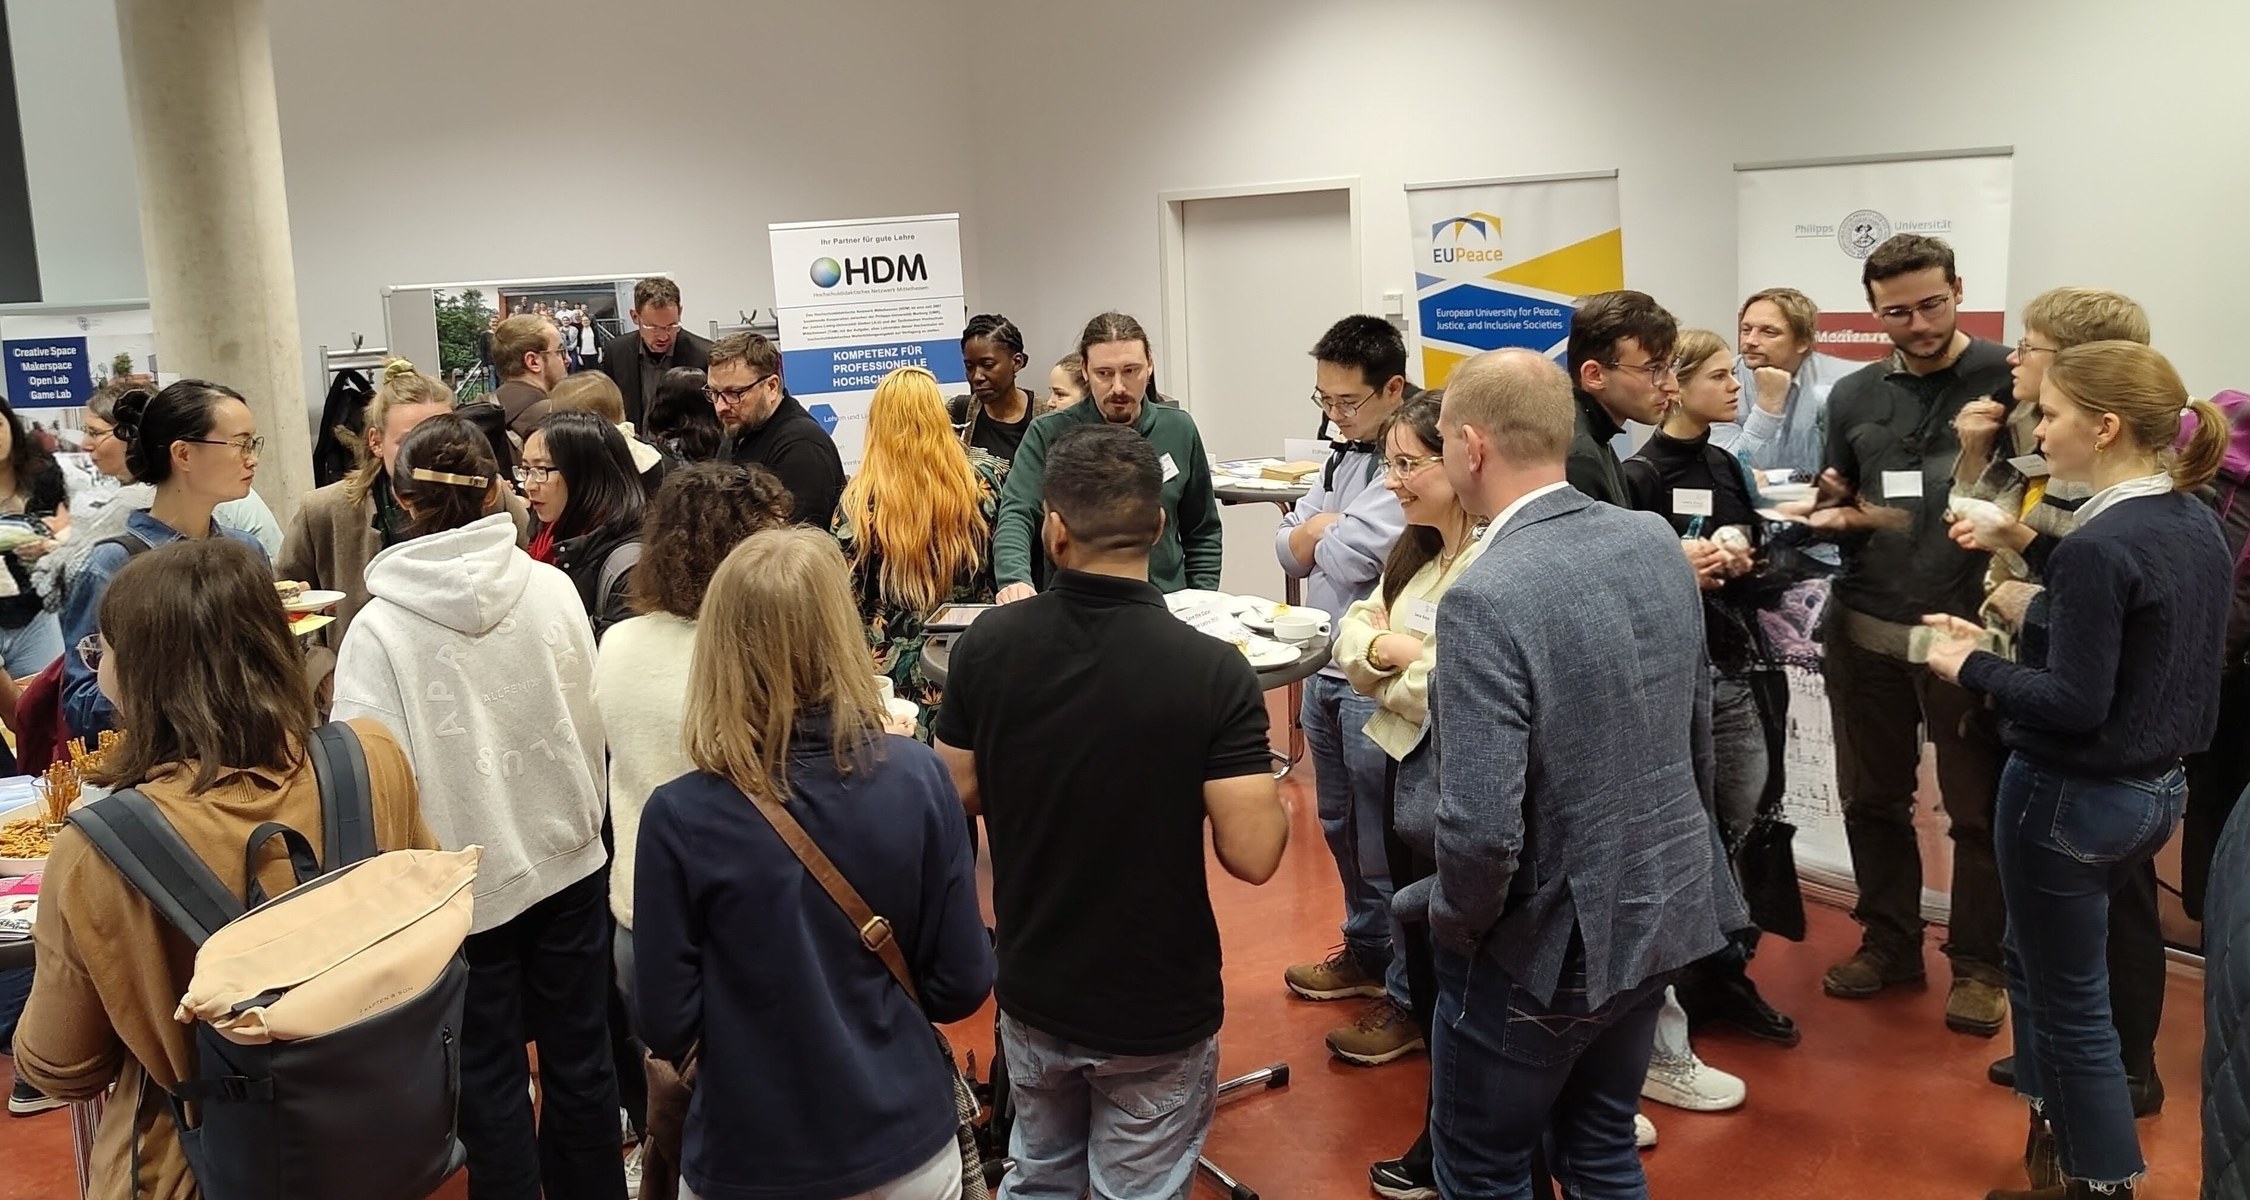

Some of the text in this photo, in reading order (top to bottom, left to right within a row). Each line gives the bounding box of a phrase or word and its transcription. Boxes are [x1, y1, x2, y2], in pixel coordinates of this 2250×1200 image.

[1795, 219, 1951, 235] Philipps Universität
[833, 237, 860, 245] Partner
[875, 235, 892, 243] gute
[894, 233, 915, 241] Lehre
[1433, 247, 1503, 263] EUPeace
[844, 253, 928, 286] HDM
[1436, 306, 1562, 319] European University for Peace,
[1436, 320, 1563, 331] Justice, and Inclusive Societies
[13, 346, 77, 358] Creative Space
[833, 345, 922, 361] KOMPETENZ FÜR
[21, 361, 73, 372] Makerspace
[833, 358, 928, 374] PROFESSIONELLE
[28, 374, 70, 387] Open Lab
[30, 388, 72, 399] Game Lab
